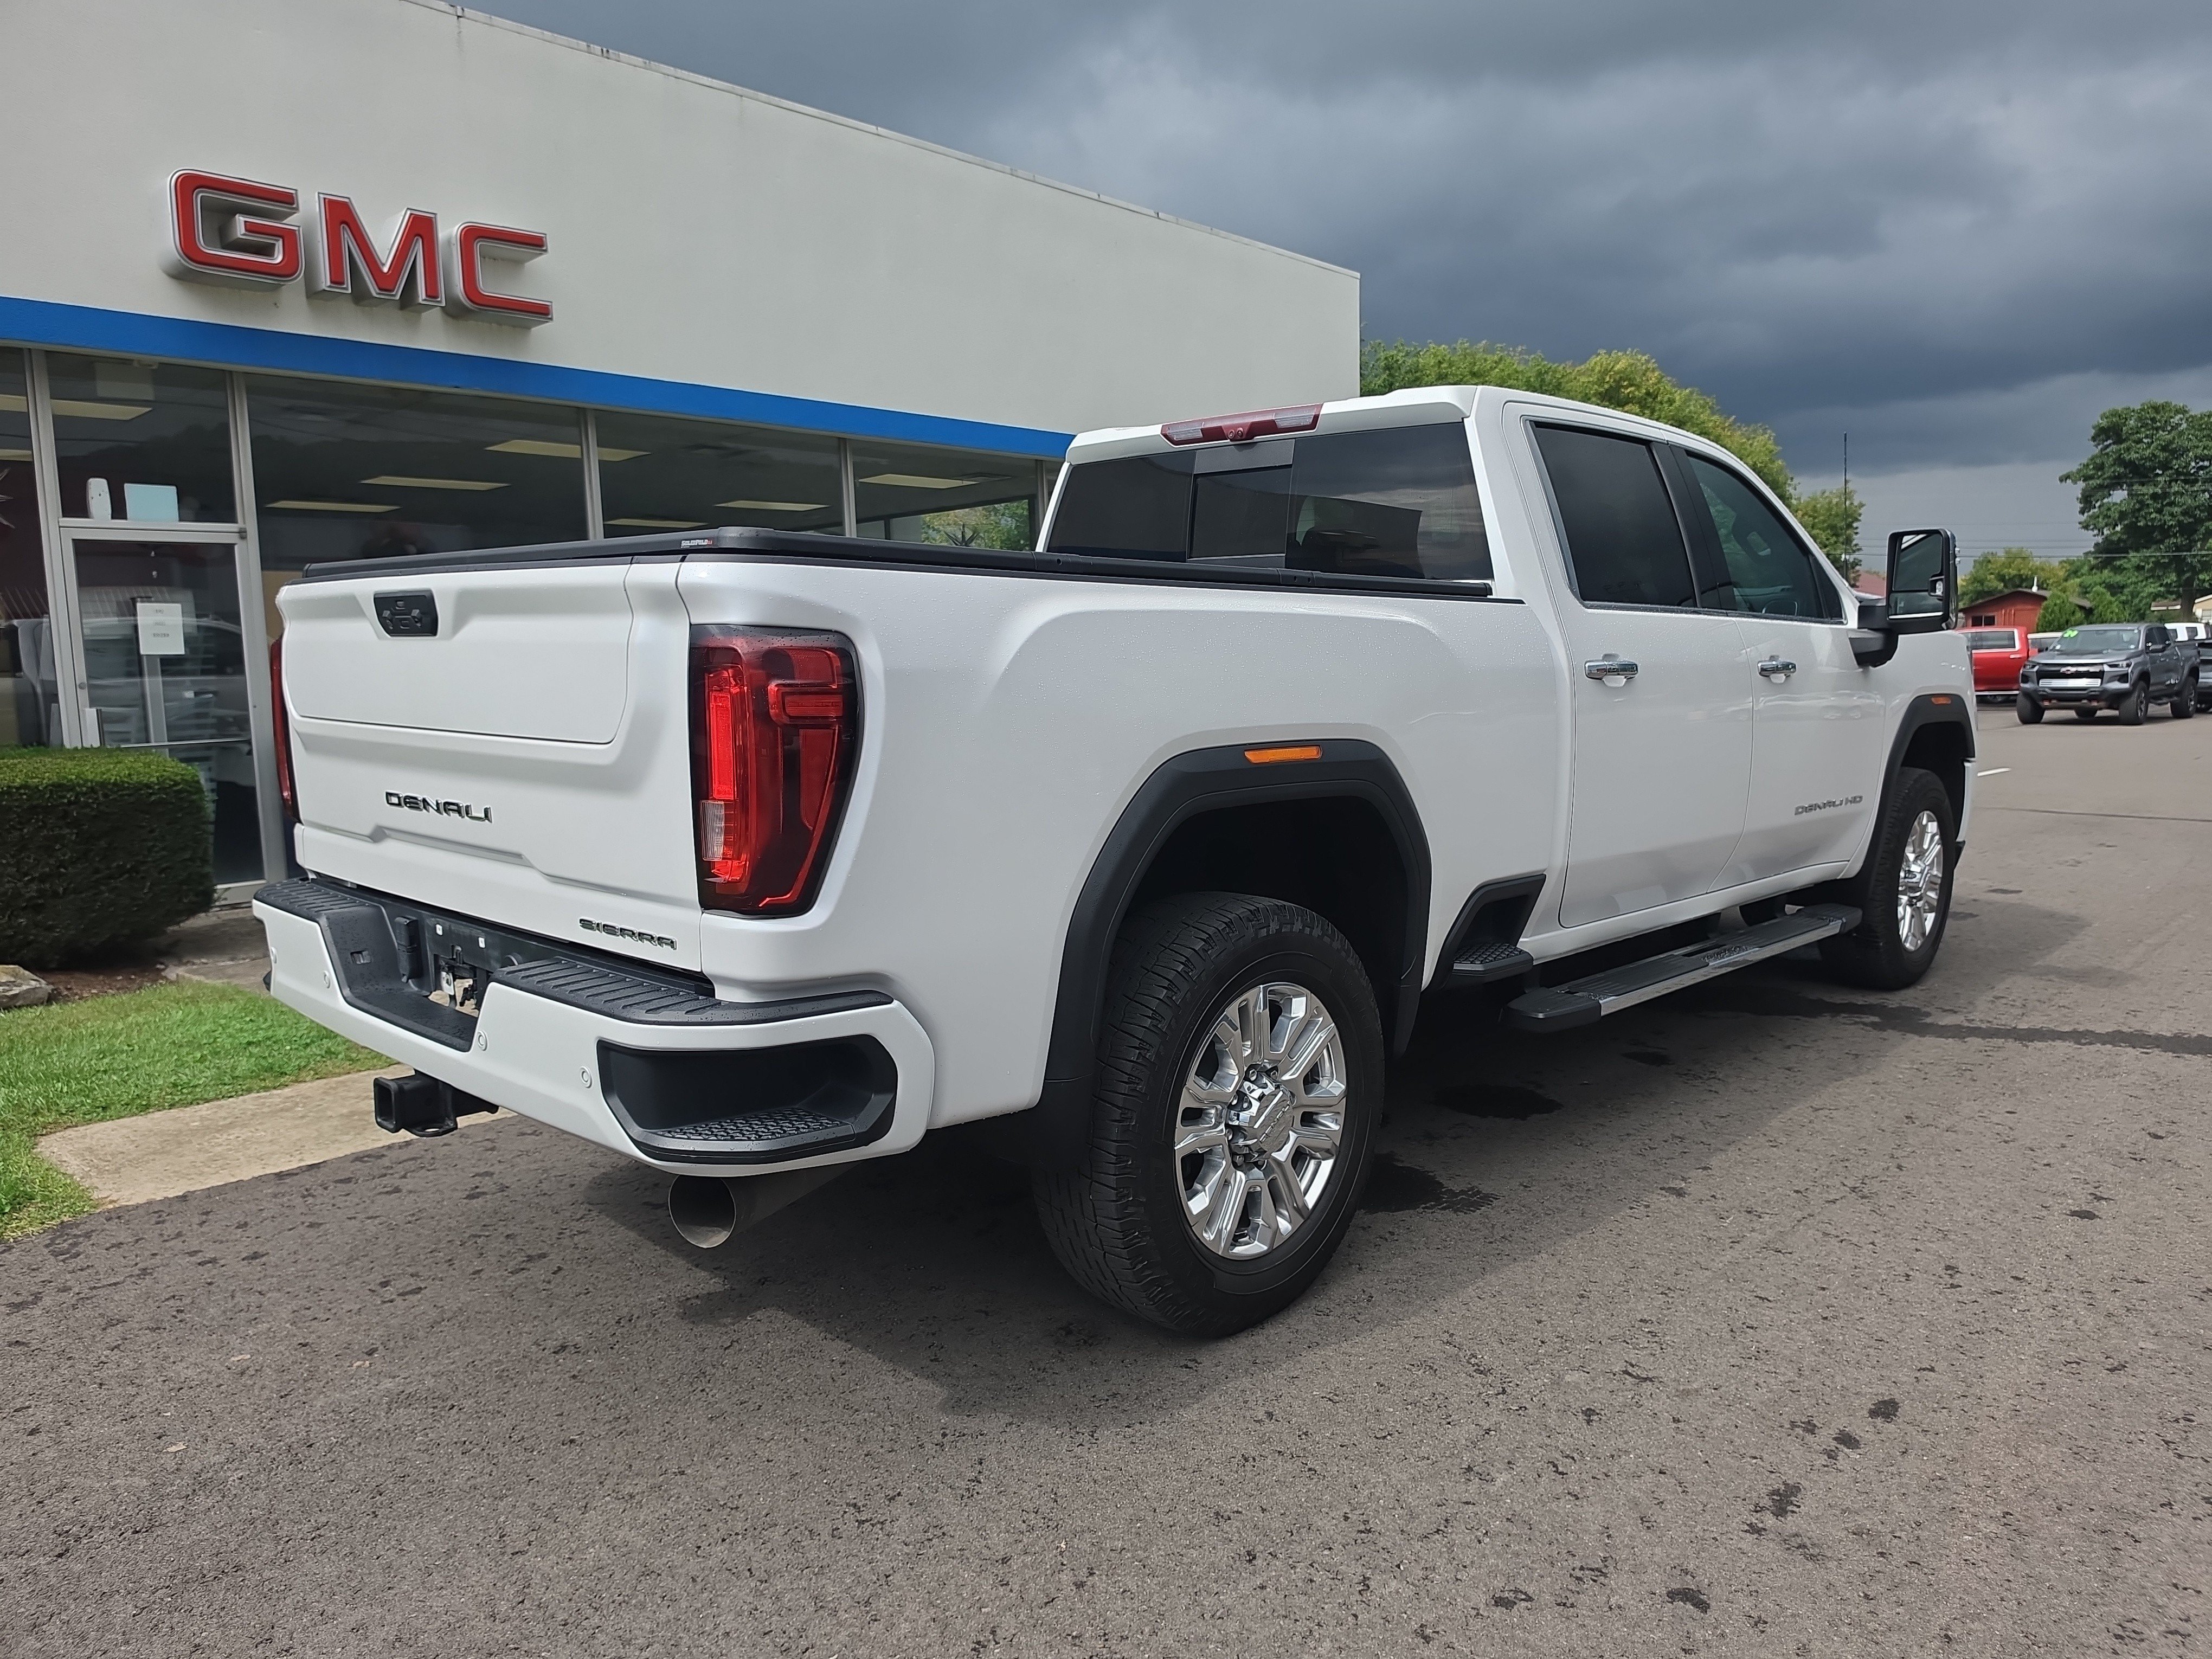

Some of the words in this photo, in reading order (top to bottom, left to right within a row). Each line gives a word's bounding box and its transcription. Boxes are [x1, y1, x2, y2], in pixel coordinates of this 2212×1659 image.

[169, 168, 554, 323] GMC
[385, 791, 492, 823] DENALI
[1795, 799, 1843, 815] DENALI
[1844, 795, 1863, 805] HD
[579, 917, 677, 950] SIERRA
